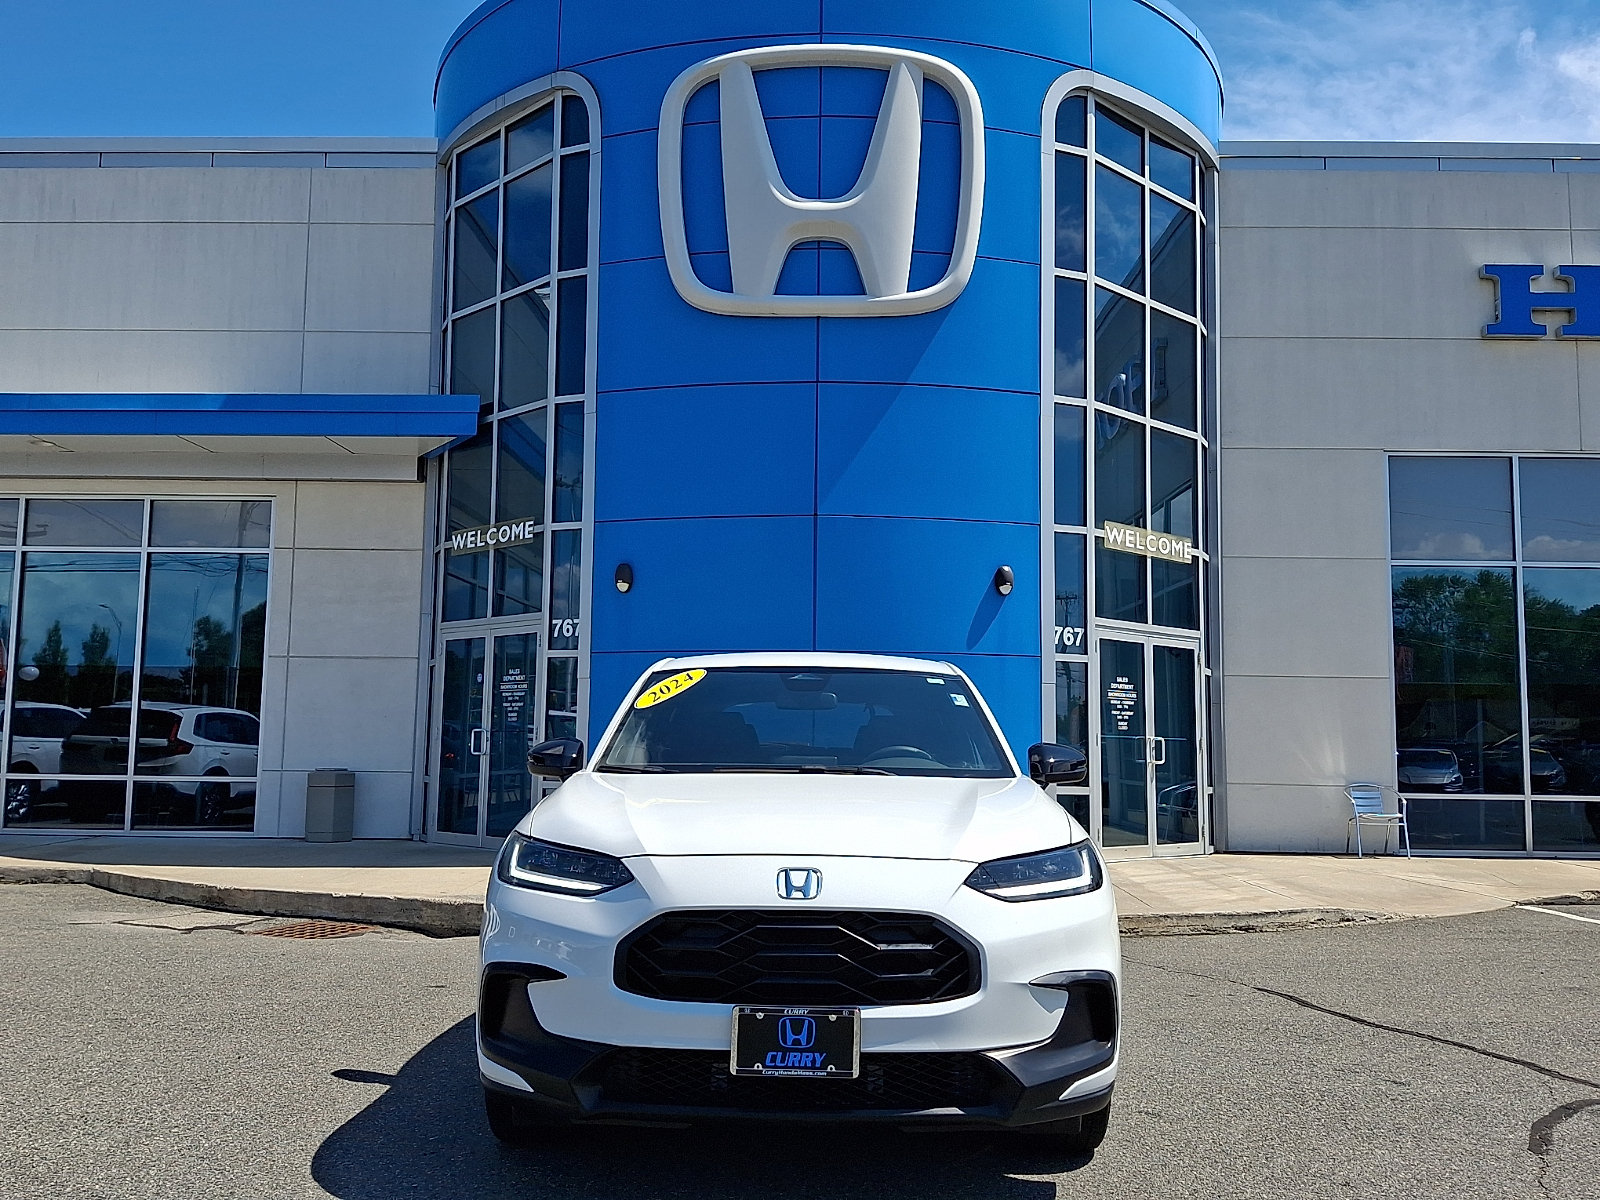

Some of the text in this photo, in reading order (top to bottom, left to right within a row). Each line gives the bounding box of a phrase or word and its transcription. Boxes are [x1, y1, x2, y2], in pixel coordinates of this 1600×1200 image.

[452, 521, 534, 550] WELCOME
[1105, 526, 1192, 559] WELCOME
[552, 619, 580, 637] 767
[1054, 626, 1084, 646] 767
[647, 672, 694, 703] 2024
[765, 1051, 826, 1067] CURRY
